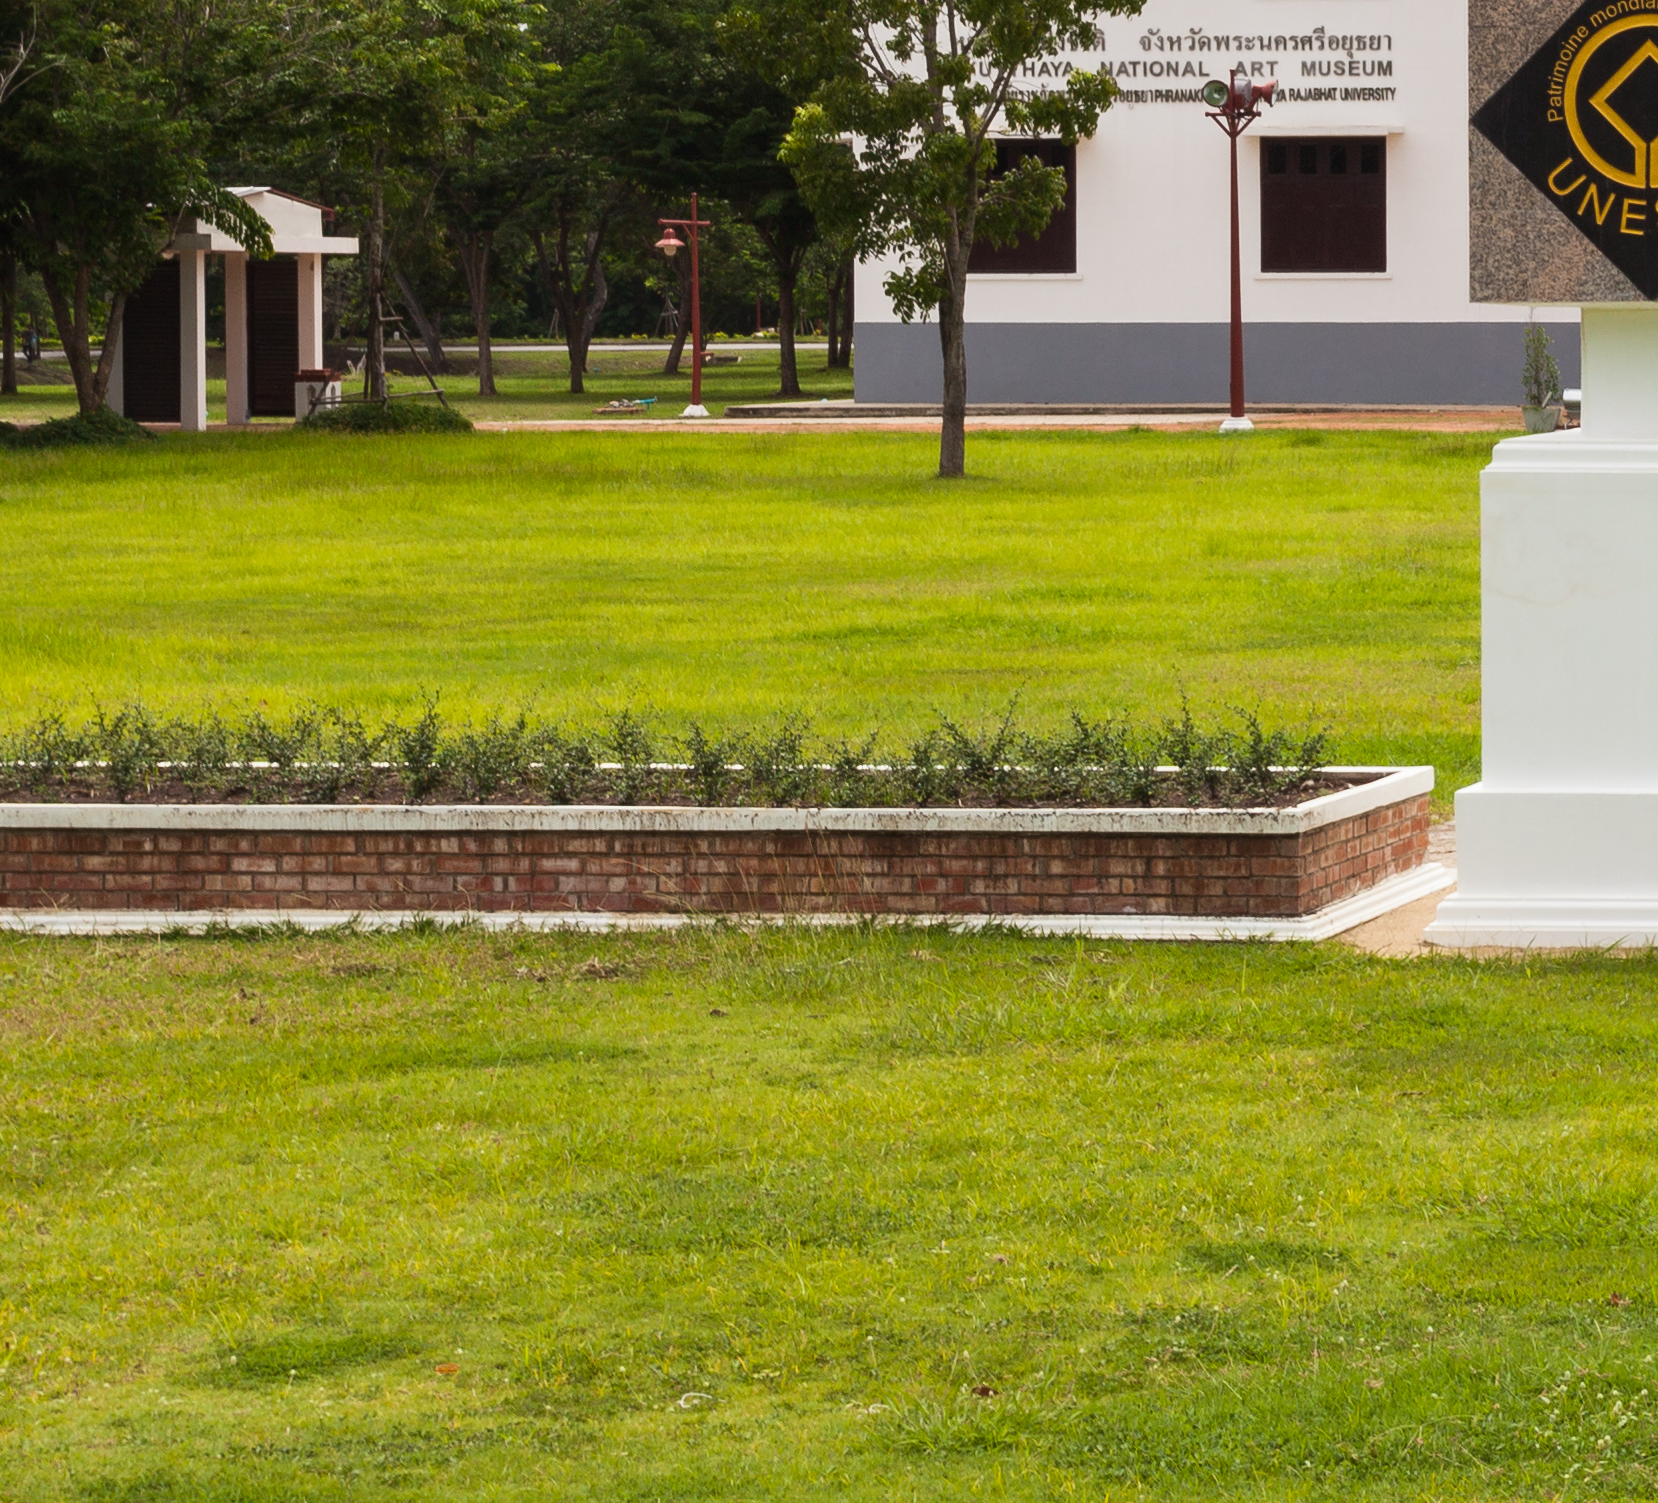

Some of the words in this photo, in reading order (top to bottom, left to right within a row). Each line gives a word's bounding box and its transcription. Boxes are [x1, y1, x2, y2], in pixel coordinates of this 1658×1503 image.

[1139, 26, 1392, 59] จังหวัดพระนครศรีอยุธยา
[1100, 61, 1210, 78] NATIONAL
[1236, 61, 1278, 77] ART
[1301, 60, 1393, 77] MUSEUM
[1547, 24, 1589, 122] Patrimoine
[1289, 87, 1337, 102] RAJABHAT
[1340, 86, 1397, 102] UNIVERSITY
